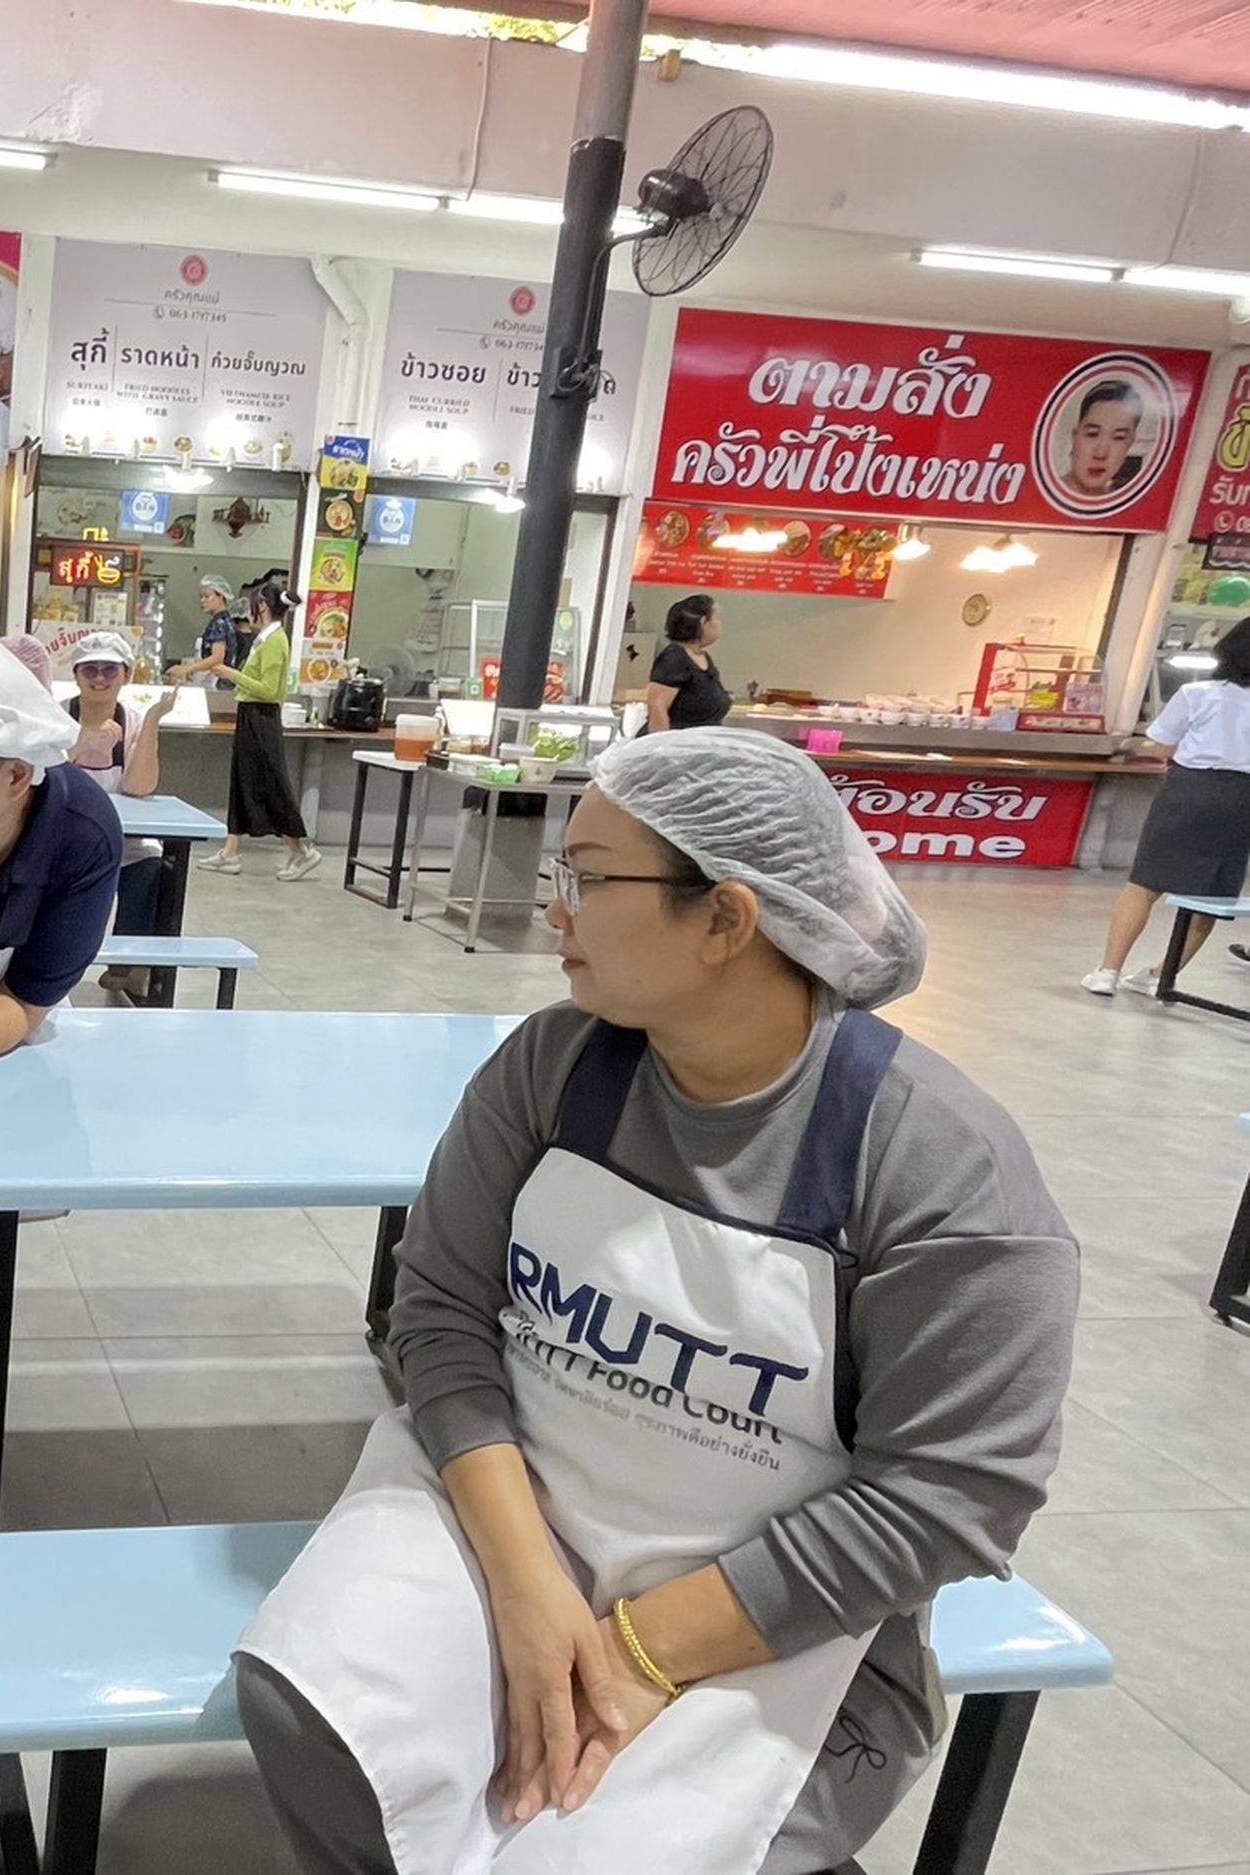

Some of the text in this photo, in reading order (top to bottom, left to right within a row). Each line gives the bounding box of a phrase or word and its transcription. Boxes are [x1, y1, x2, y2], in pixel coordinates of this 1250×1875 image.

[70, 328, 110, 371] สุกี้
[121, 345, 200, 369] ราดหน้า
[400, 352, 487, 384] ข้าวซอย
[750, 334, 992, 418] ตามสั่ง
[58, 551, 95, 584] สุกี้
[511, 1242, 810, 1418] RMUTT
